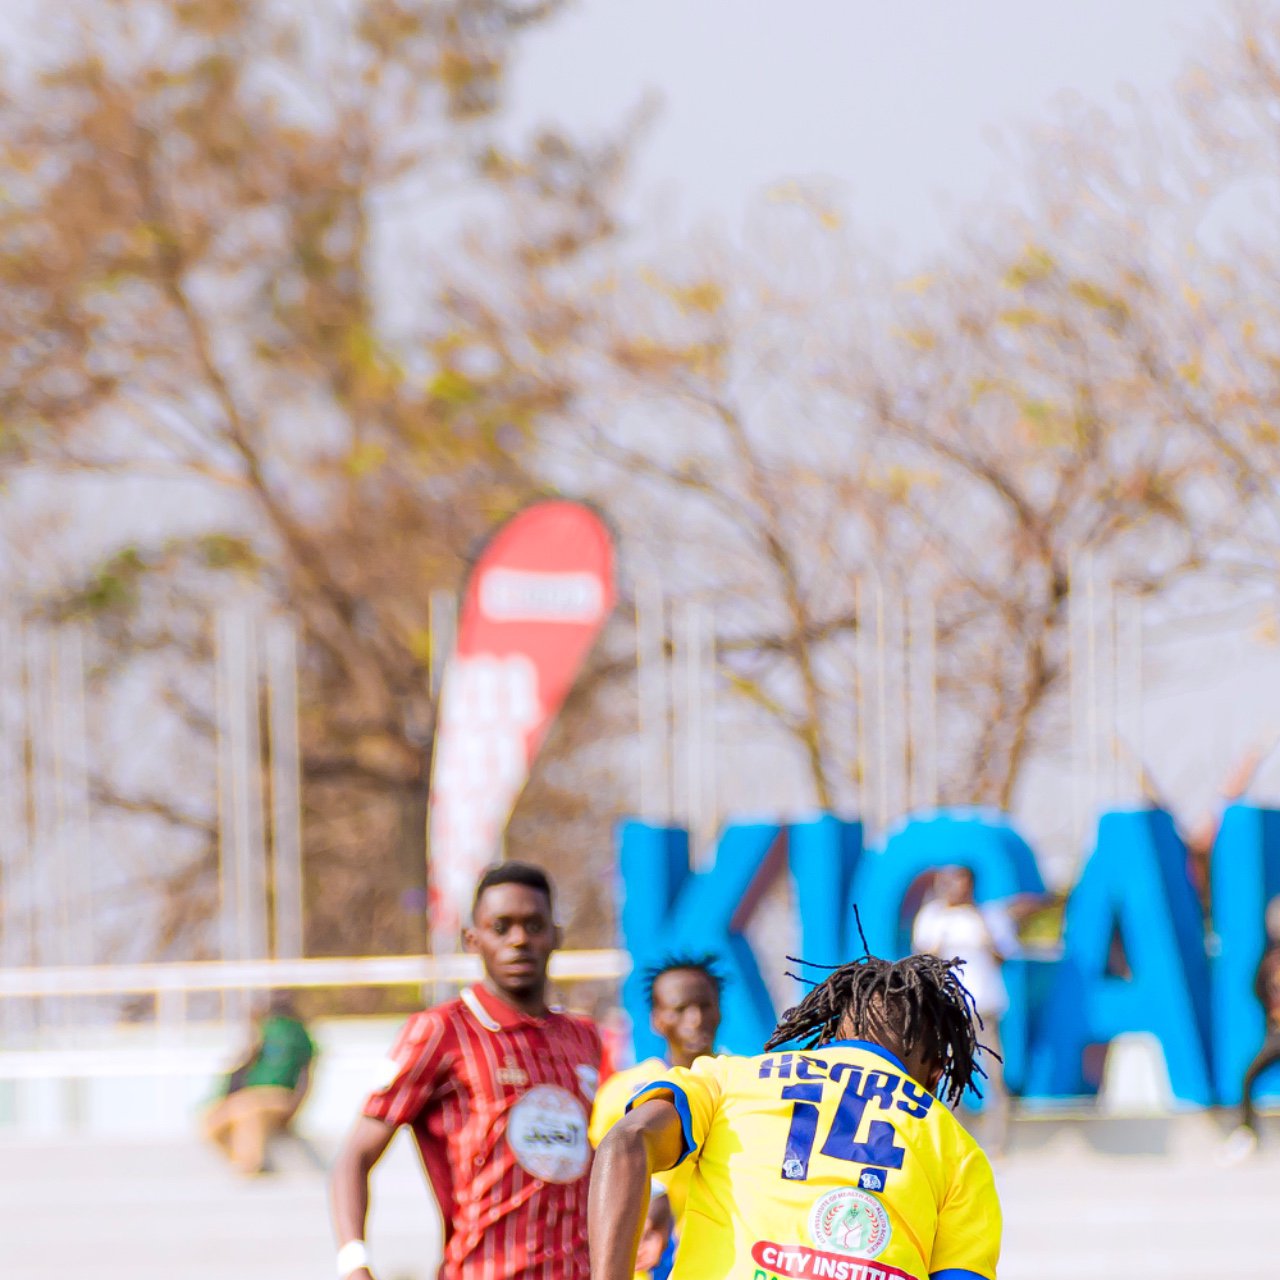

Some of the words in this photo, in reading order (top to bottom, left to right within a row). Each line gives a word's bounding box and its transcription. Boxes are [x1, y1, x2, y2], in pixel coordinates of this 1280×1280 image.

[759, 1054, 934, 1119] HENRY
[781, 1083, 905, 1193] 14
[762, 1247, 811, 1274] CITY
